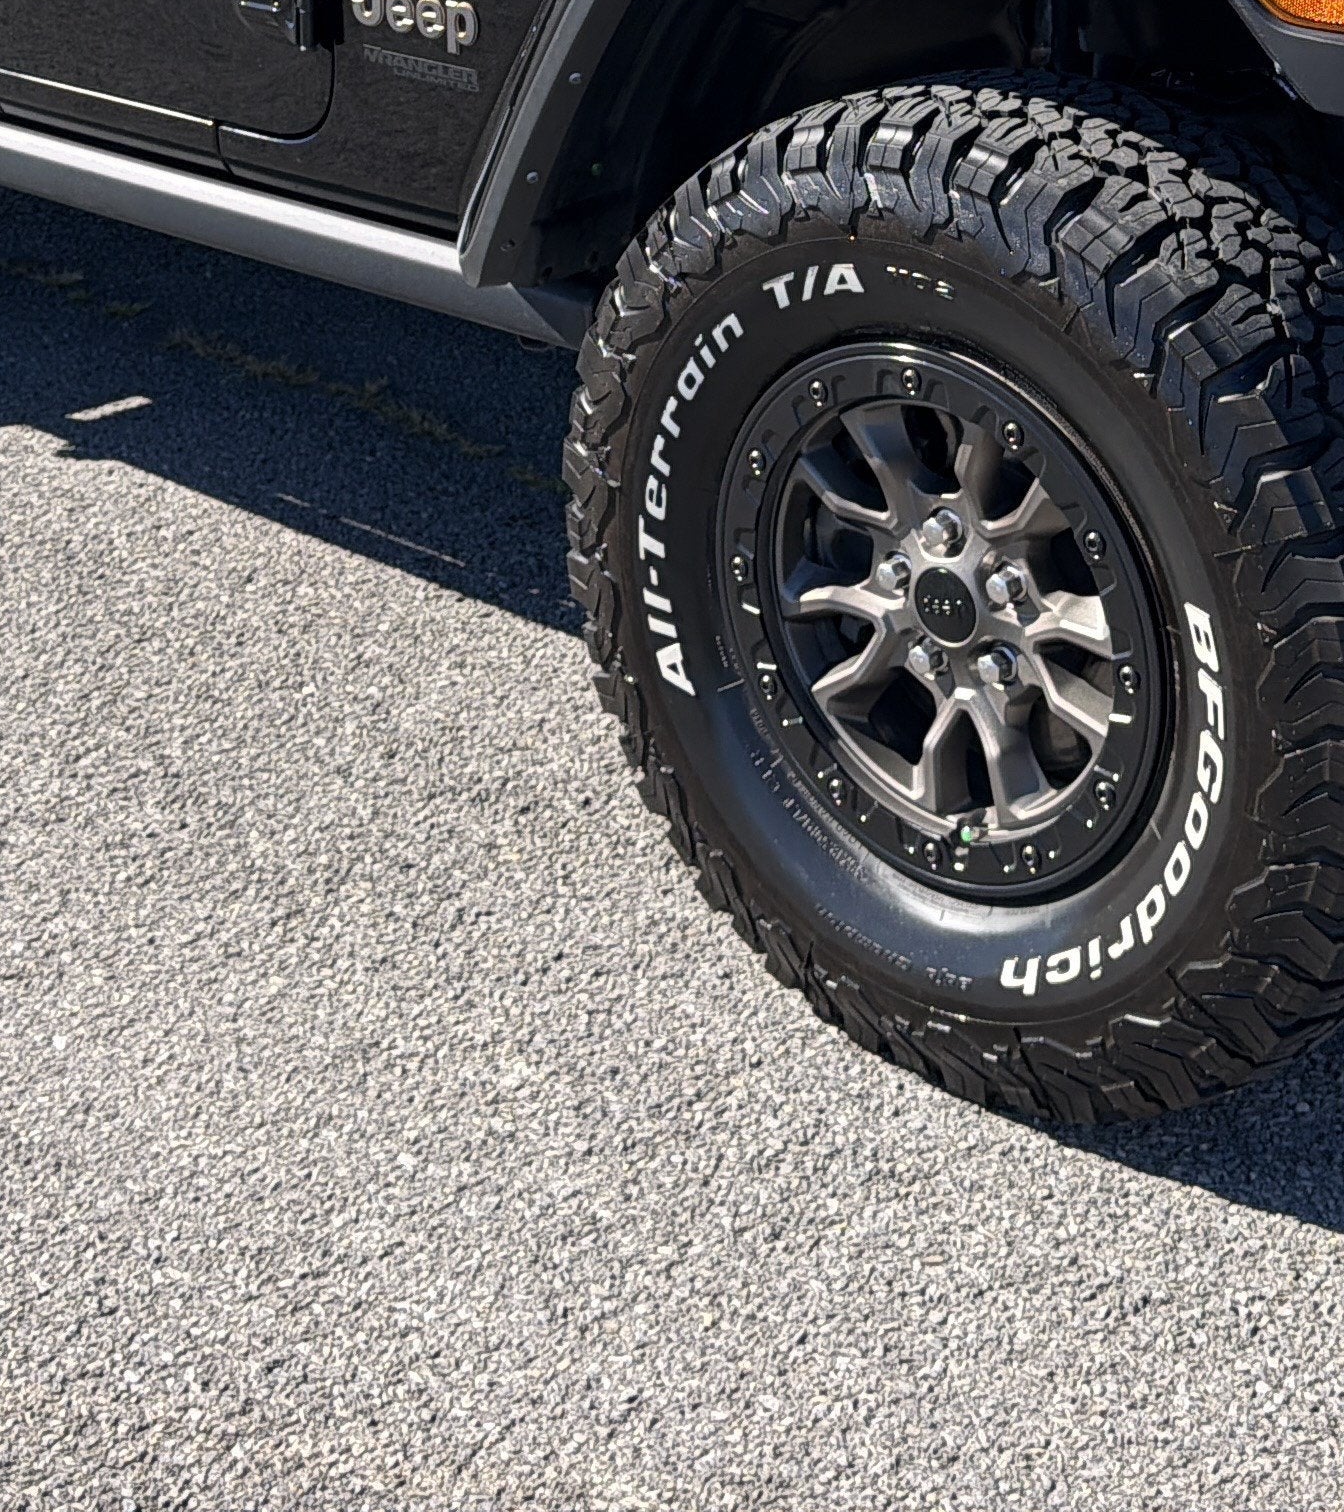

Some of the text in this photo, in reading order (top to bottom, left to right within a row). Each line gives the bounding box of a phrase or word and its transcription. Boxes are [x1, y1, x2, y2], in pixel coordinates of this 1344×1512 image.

[362, 43, 478, 86] WRANGLER
[636, 263, 866, 696] All-Terrain T/A
[1000, 600, 1229, 998] BFGoodrich
